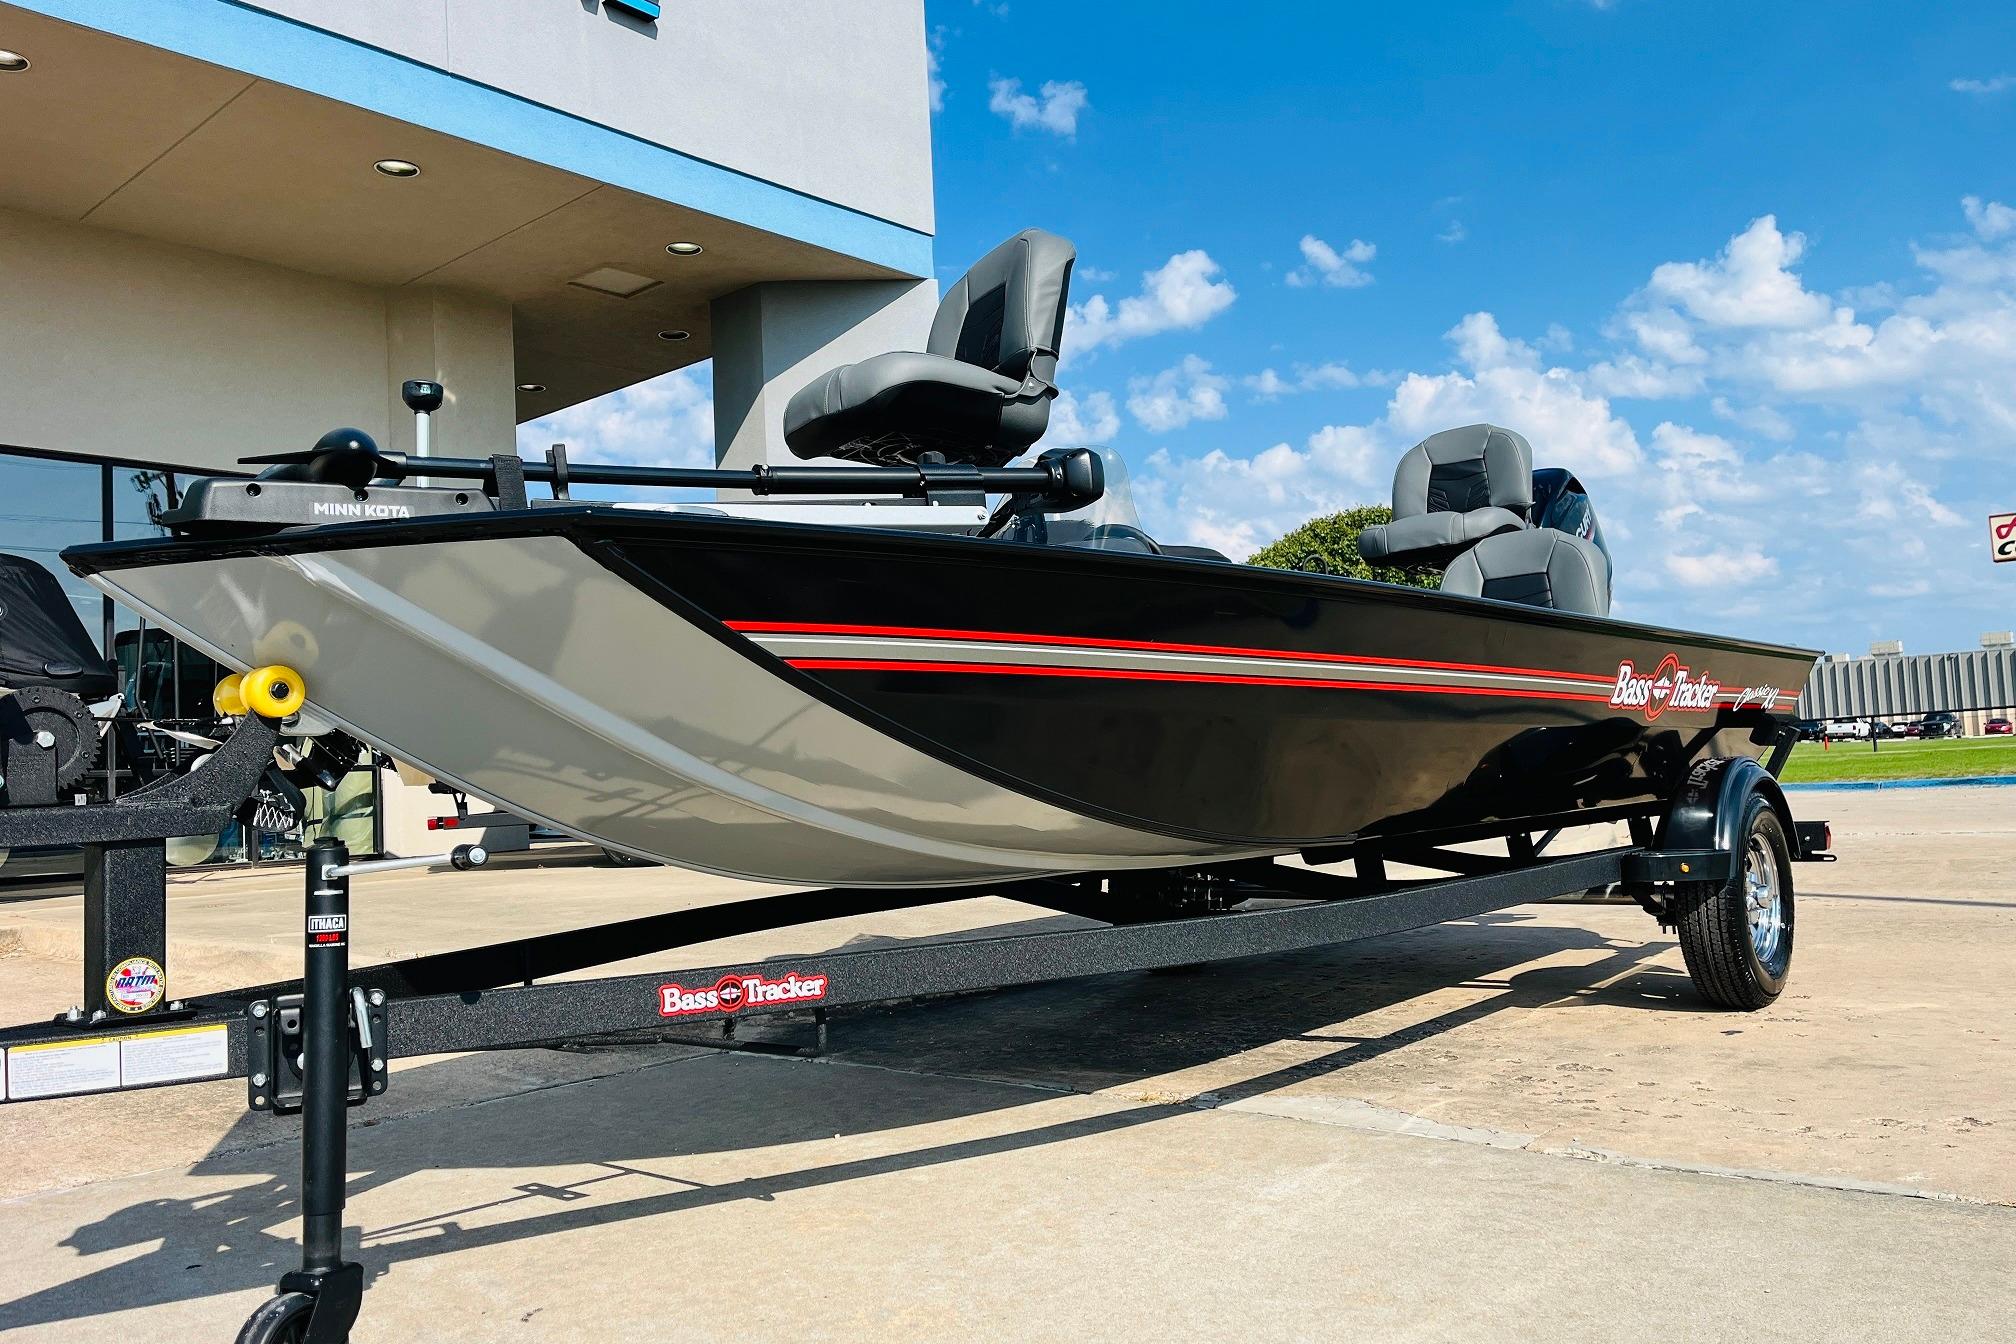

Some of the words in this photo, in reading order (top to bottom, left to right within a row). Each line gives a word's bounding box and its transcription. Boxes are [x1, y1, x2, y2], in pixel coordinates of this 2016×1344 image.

[313, 502, 360, 516] MINN
[364, 504, 410, 518] KOTA
[1611, 664, 1652, 705] Bass
[1669, 669, 1719, 708] Tracker
[310, 917, 344, 930] ITHACA
[662, 988, 719, 1013] Bass
[742, 976, 824, 1003] Tracker
